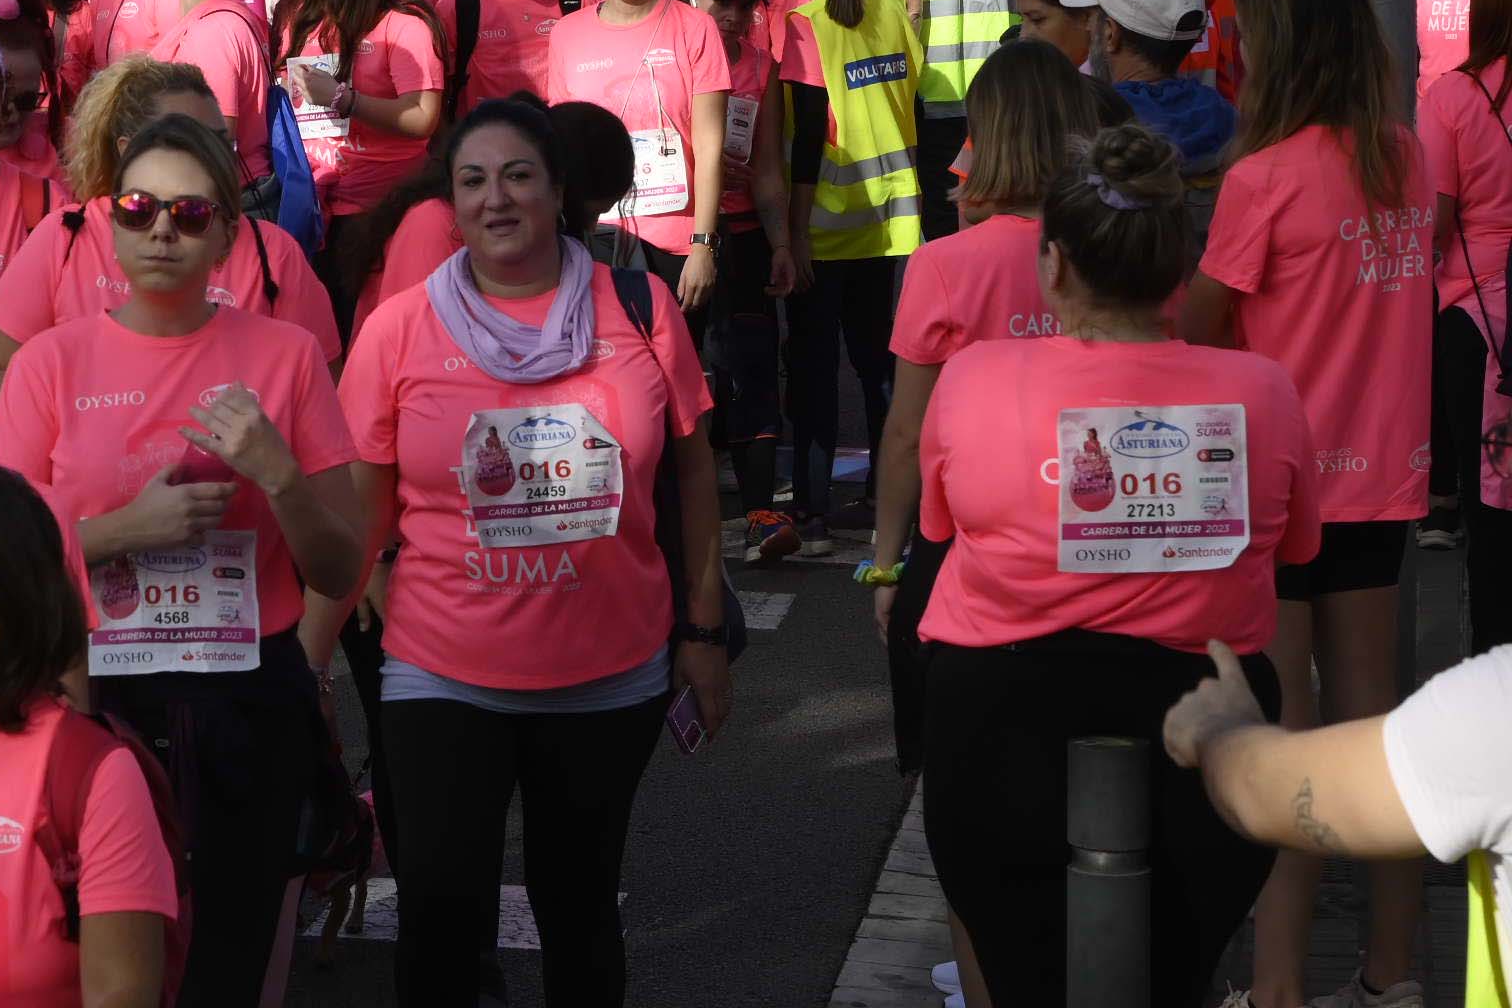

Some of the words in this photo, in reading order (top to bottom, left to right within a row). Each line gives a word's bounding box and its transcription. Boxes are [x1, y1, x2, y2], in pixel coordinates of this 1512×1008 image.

[1431, 1, 1450, 15] DE
[1428, 16, 1469, 31] MUJE
[1398, 234, 1421, 255] LA
[1355, 255, 1425, 286] MUJER
[75, 390, 145, 412] OYSHO
[514, 429, 571, 443] ASTURIANA
[1196, 428, 1232, 437] SUMA
[1116, 435, 1183, 450] ASTURIANA
[519, 459, 572, 482] 016
[1316, 456, 1368, 473] YSHO
[1120, 472, 1183, 495] 016
[526, 485, 566, 500] 24459
[488, 506, 529, 517] CARRERA
[531, 505, 543, 513] DE
[545, 504, 557, 512] LA
[560, 501, 587, 511] MUJER
[591, 499, 609, 508] 2023
[1127, 503, 1176, 518] 27213
[488, 525, 532, 537] OYSHO
[569, 516, 613, 530] Santander
[1081, 525, 1127, 537] CARRERA
[1132, 526, 1147, 534] DE
[1149, 526, 1163, 534] LA
[1165, 525, 1202, 533] MUJER
[1206, 524, 1230, 533] 2023
[1075, 548, 1131, 562] OYSHO
[1178, 546, 1234, 558] Santander
[464, 550, 578, 583] SUMA
[144, 584, 201, 604] 016
[154, 611, 189, 624] 4568
[108, 631, 152, 641] CARRERA
[155, 631, 167, 640] DE
[170, 630, 182, 640] LA
[185, 630, 217, 639] MUJER
[220, 631, 242, 639] 2023
[103, 651, 153, 664] OYSHO
[196, 651, 246, 662] Santander
